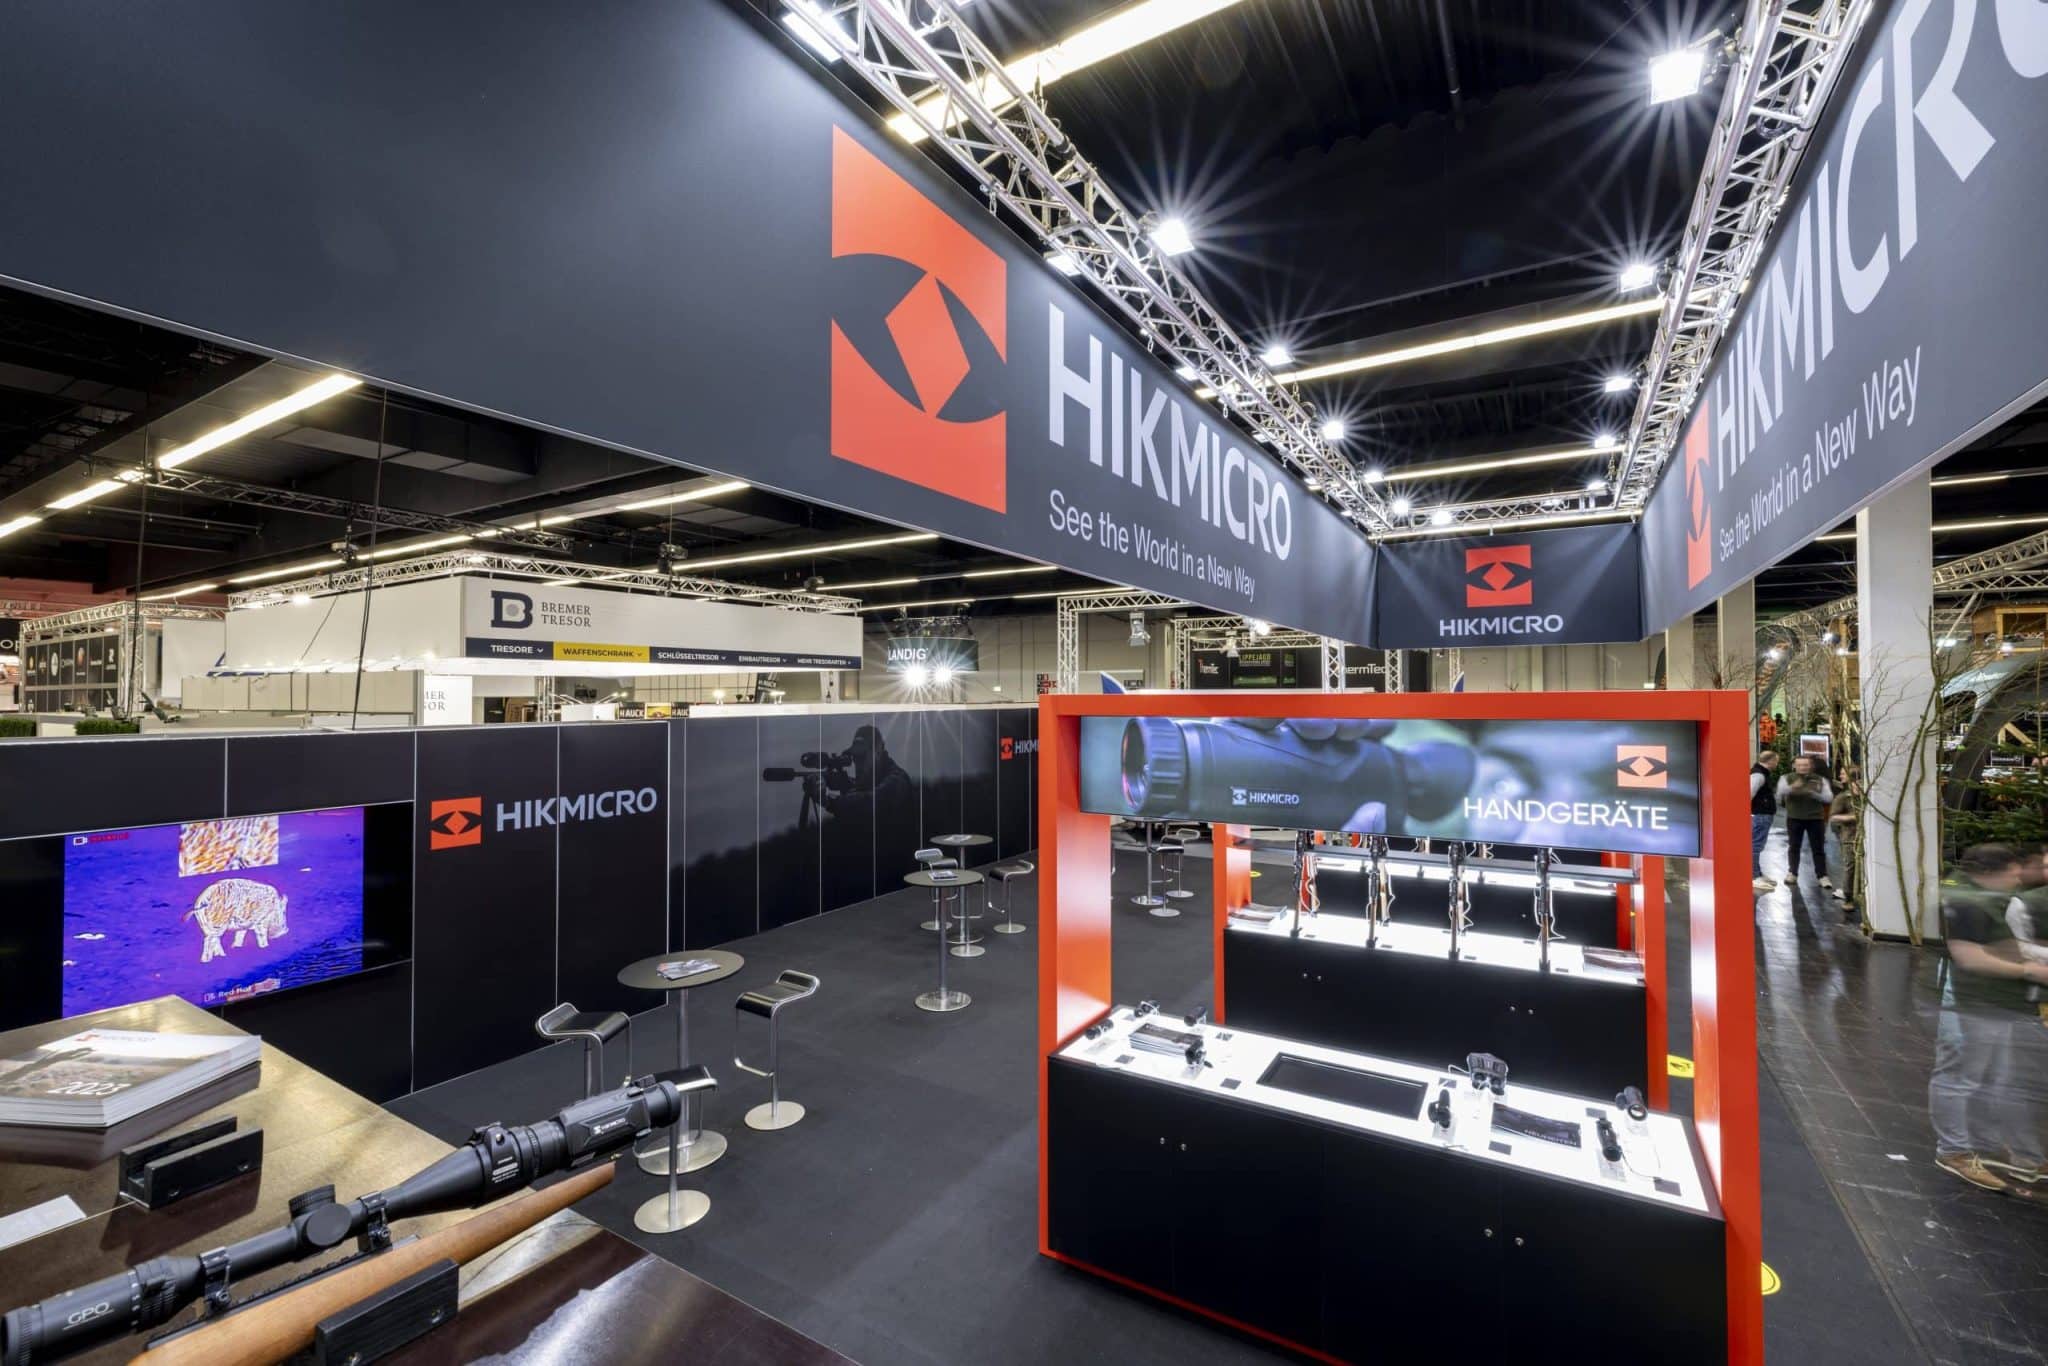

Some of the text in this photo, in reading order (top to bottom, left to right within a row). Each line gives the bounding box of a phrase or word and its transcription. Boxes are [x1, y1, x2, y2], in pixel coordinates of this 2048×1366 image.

[1050, 302, 1292, 560] HIKMICRO
[1719, 345, 1921, 562] See the World in a New Way
[1050, 490, 1255, 602] See the World in a New Way
[541, 602, 592, 616] BREMER
[541, 614, 592, 627] TRESOR
[1440, 614, 1563, 636] HIKMICRO
[490, 645, 534, 654] TRESORE
[563, 648, 634, 657] WAFFENSCHRANK
[657, 652, 719, 661] SCHLÜSSELTRESOR
[888, 648, 926, 661] LANDIG
[1249, 791, 1300, 805] HIKMICRO
[496, 787, 657, 832] HIKMICRO
[1464, 797, 1669, 830] HANDGERÄTE
[68, 1302, 110, 1324] GPO
